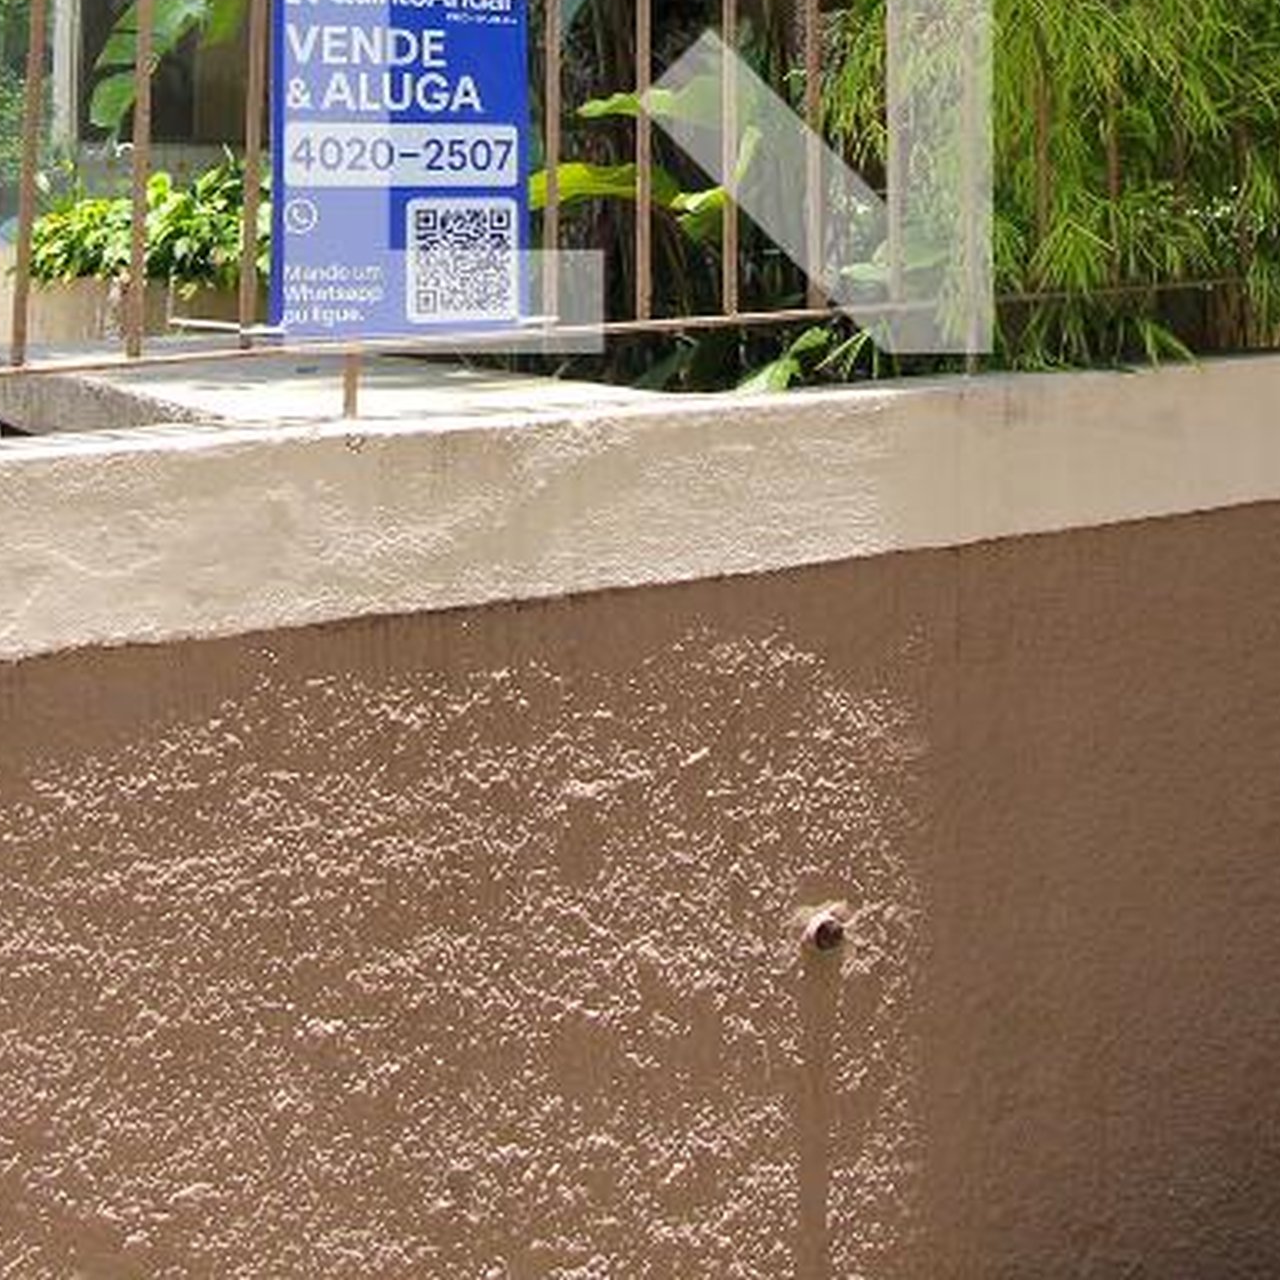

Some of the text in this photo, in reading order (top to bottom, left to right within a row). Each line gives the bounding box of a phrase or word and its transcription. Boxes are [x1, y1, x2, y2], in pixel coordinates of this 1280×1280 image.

[286, 24, 447, 68] VENDE
[286, 72, 484, 113] & ALUGA
[290, 136, 514, 171] 4020-2507
